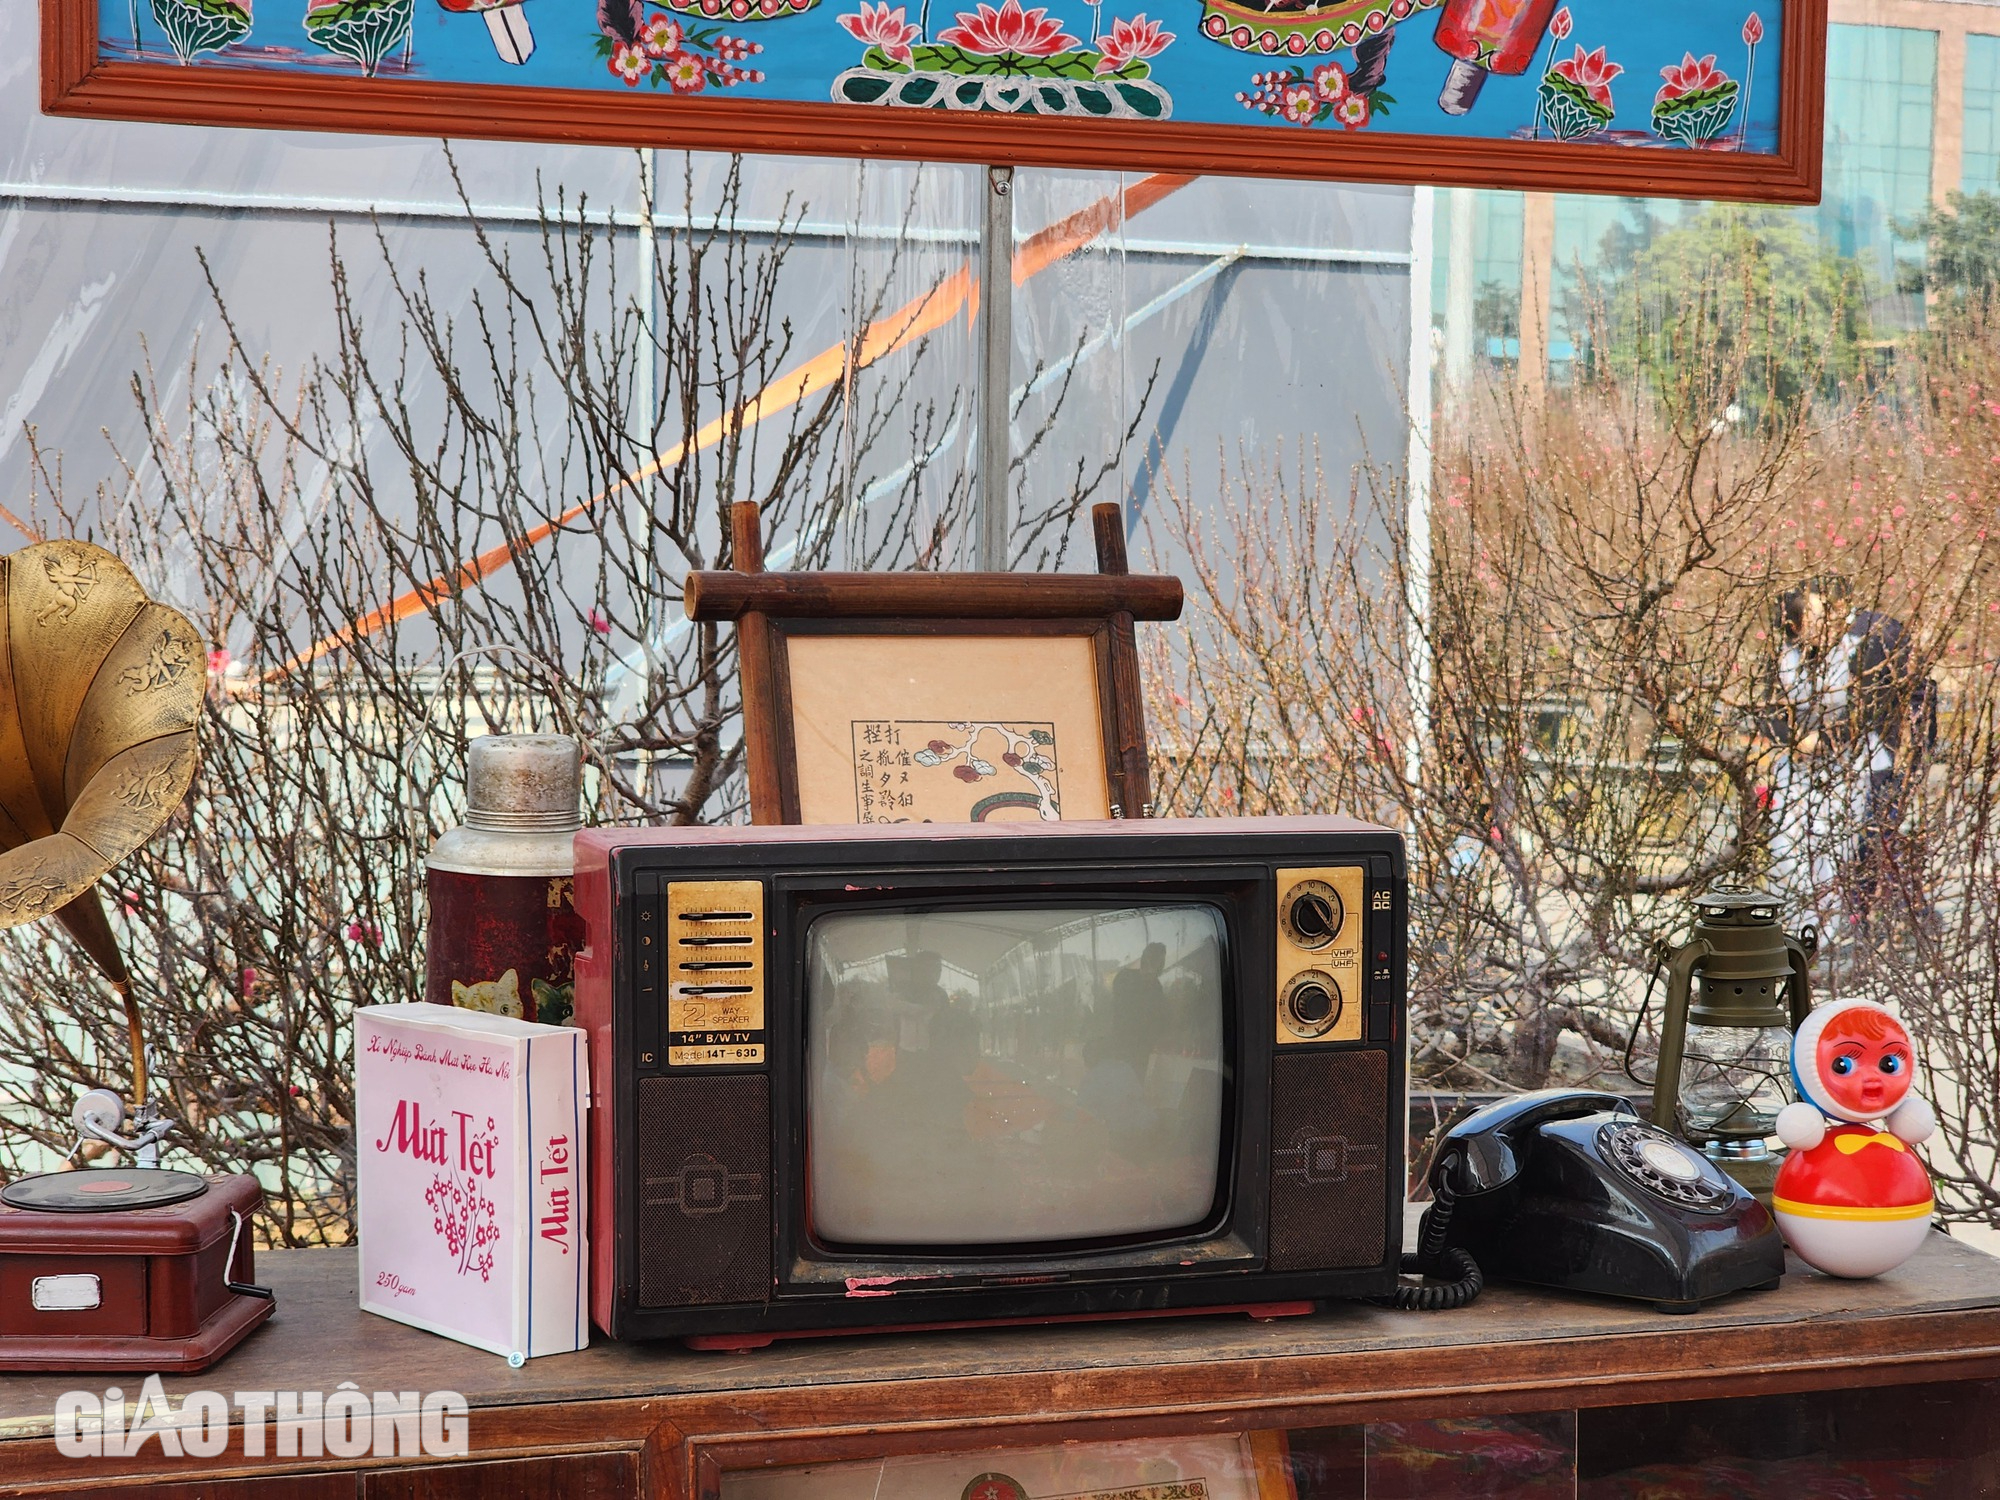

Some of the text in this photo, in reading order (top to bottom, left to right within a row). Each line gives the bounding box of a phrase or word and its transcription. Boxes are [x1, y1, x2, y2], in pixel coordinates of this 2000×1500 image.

[1308, 881, 1315, 889] 10
[1373, 891, 1391, 899] AC
[1281, 904, 1286, 912] 7
[1373, 902, 1391, 910] DC
[683, 1001, 740, 1028] 2 WAY
[712, 1016, 750, 1024] SPEAKER
[706, 1033, 731, 1043] B/W
[734, 1033, 750, 1042] TV
[641, 1053, 653, 1062] IC
[674, 1051, 705, 1060] Model
[451, 1110, 496, 1179] Tết
[540, 1134, 568, 1184] Tết
